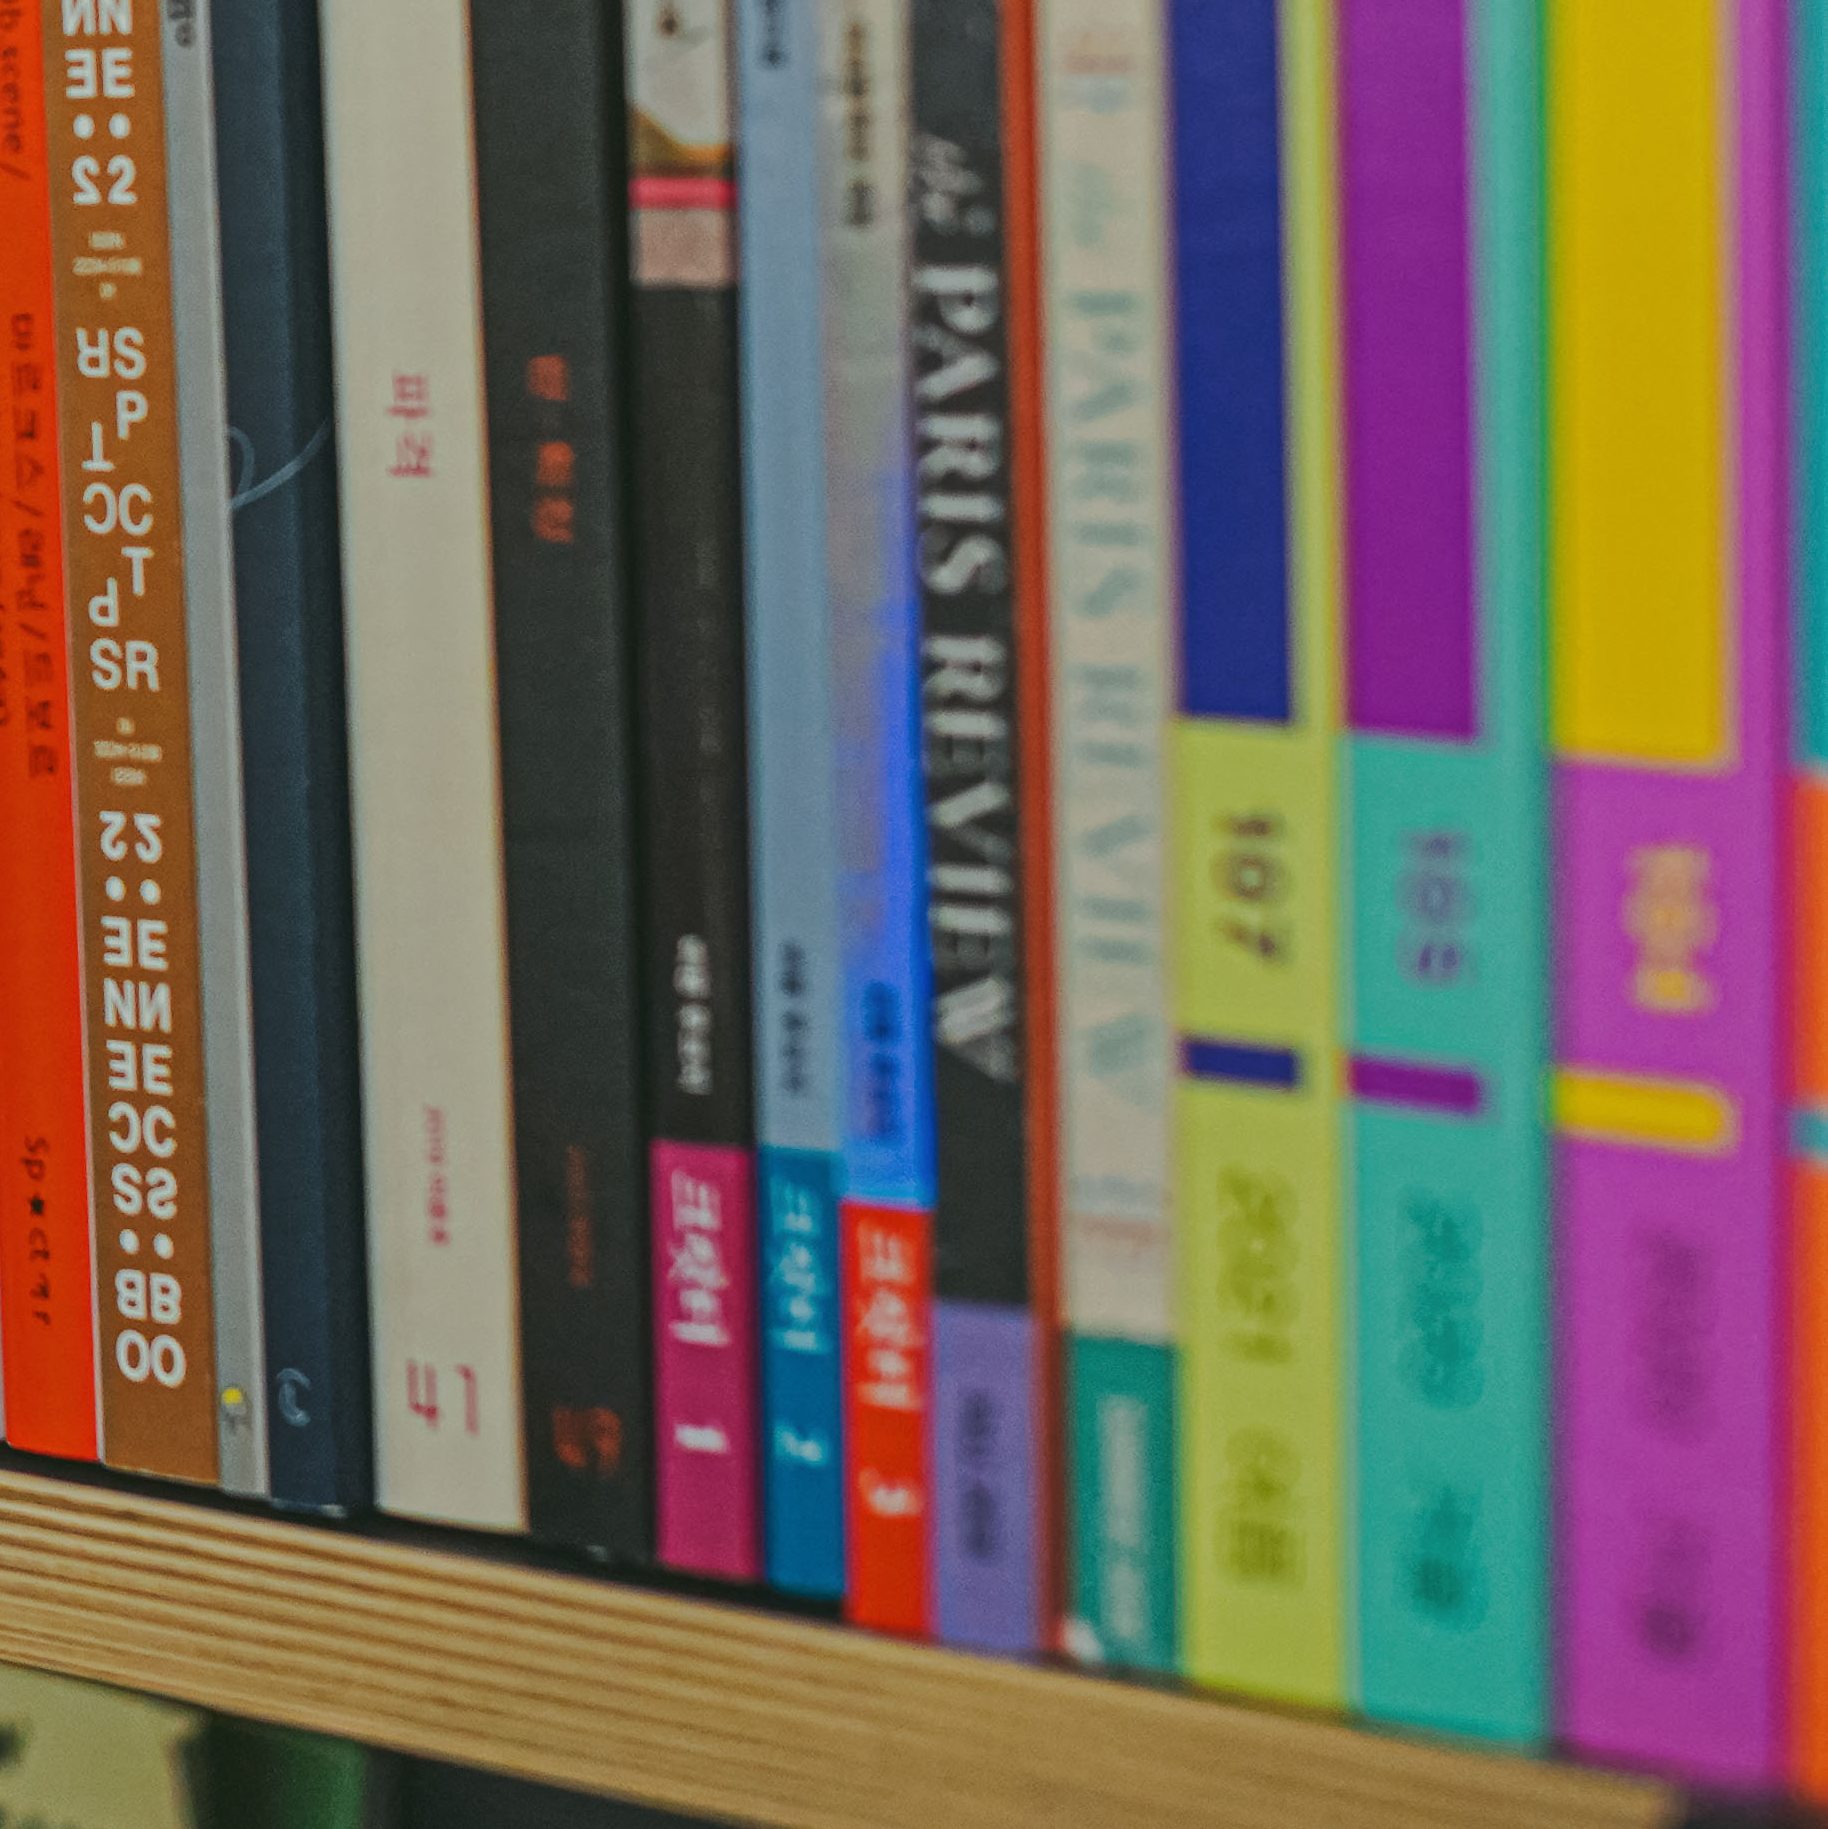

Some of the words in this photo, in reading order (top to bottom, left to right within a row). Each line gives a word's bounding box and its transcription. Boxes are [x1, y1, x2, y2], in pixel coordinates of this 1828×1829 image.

[915, 264, 1007, 598] PARIS
[923, 634, 1019, 1084] REVIEW
[1211, 807, 1288, 967] 107
